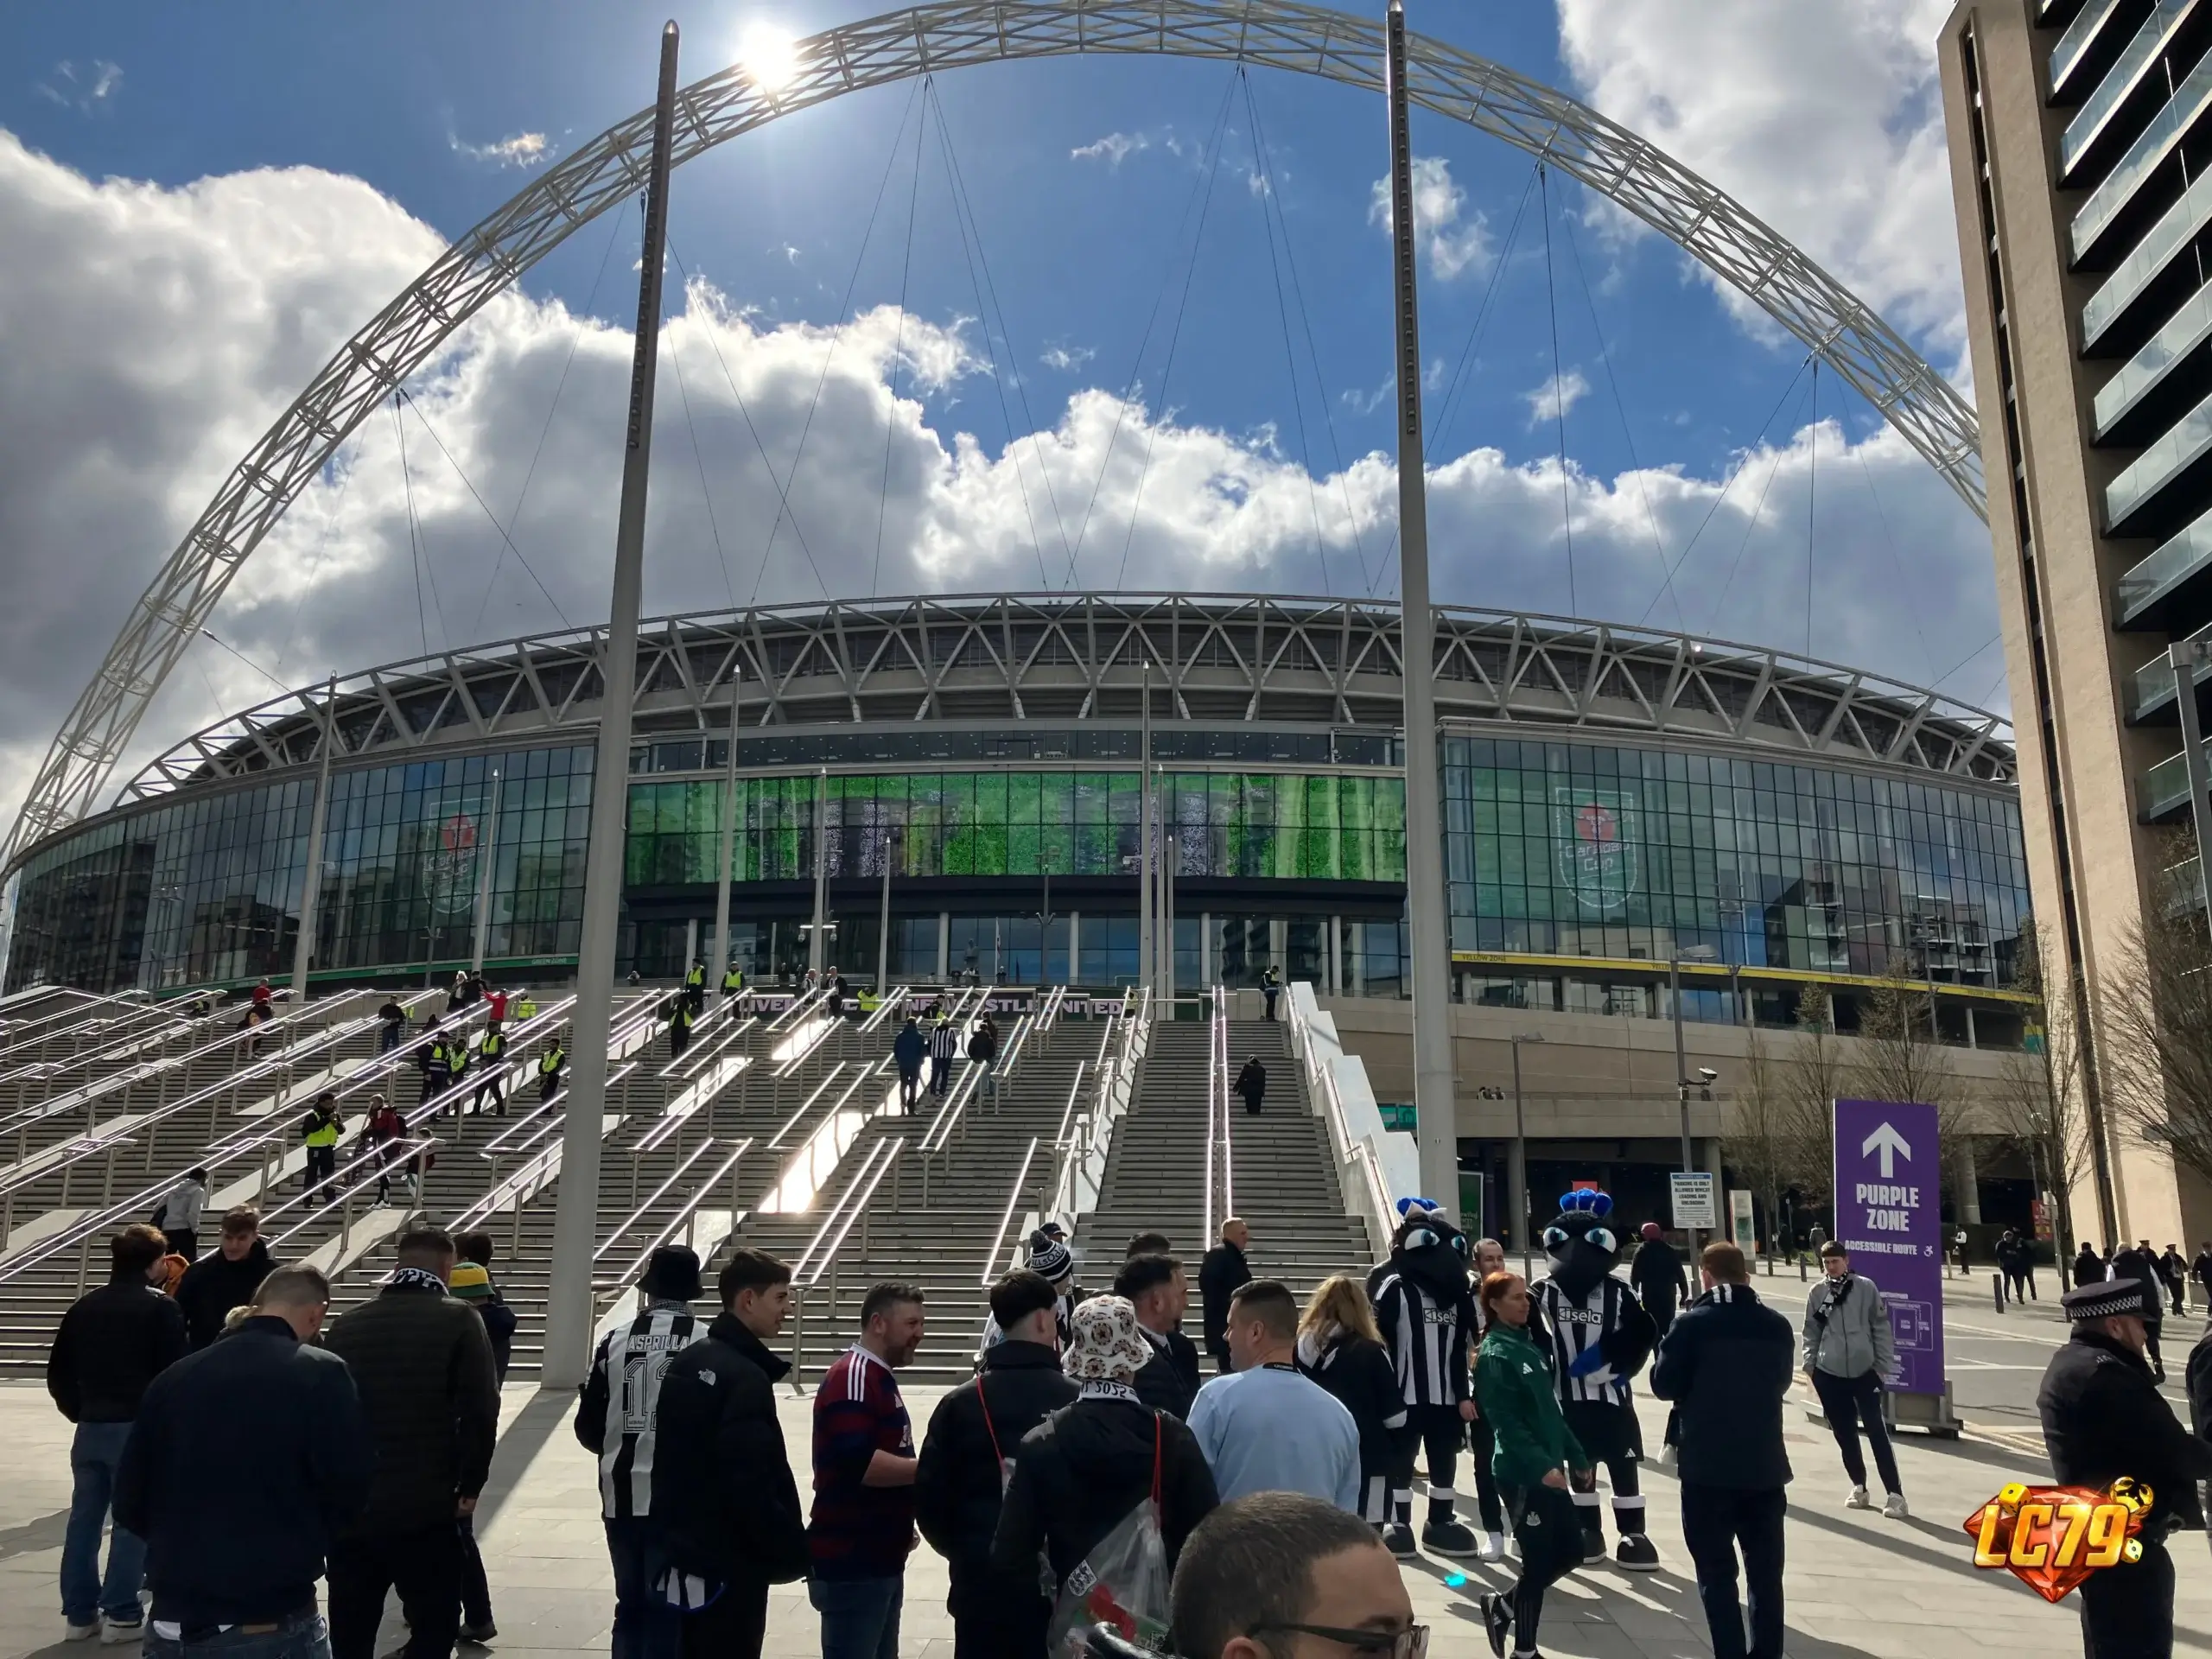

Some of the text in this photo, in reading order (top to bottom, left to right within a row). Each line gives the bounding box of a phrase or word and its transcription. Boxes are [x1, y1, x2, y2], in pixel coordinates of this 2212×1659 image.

[1856, 1183, 1920, 1208] PURPLE
[1866, 1208, 1910, 1232] ZONE
[1844, 1239, 1917, 1255] ACCESSIBLE ROUTE
[1571, 1310, 1602, 1324] sela
[626, 1334, 690, 1352] ASPRILLA
